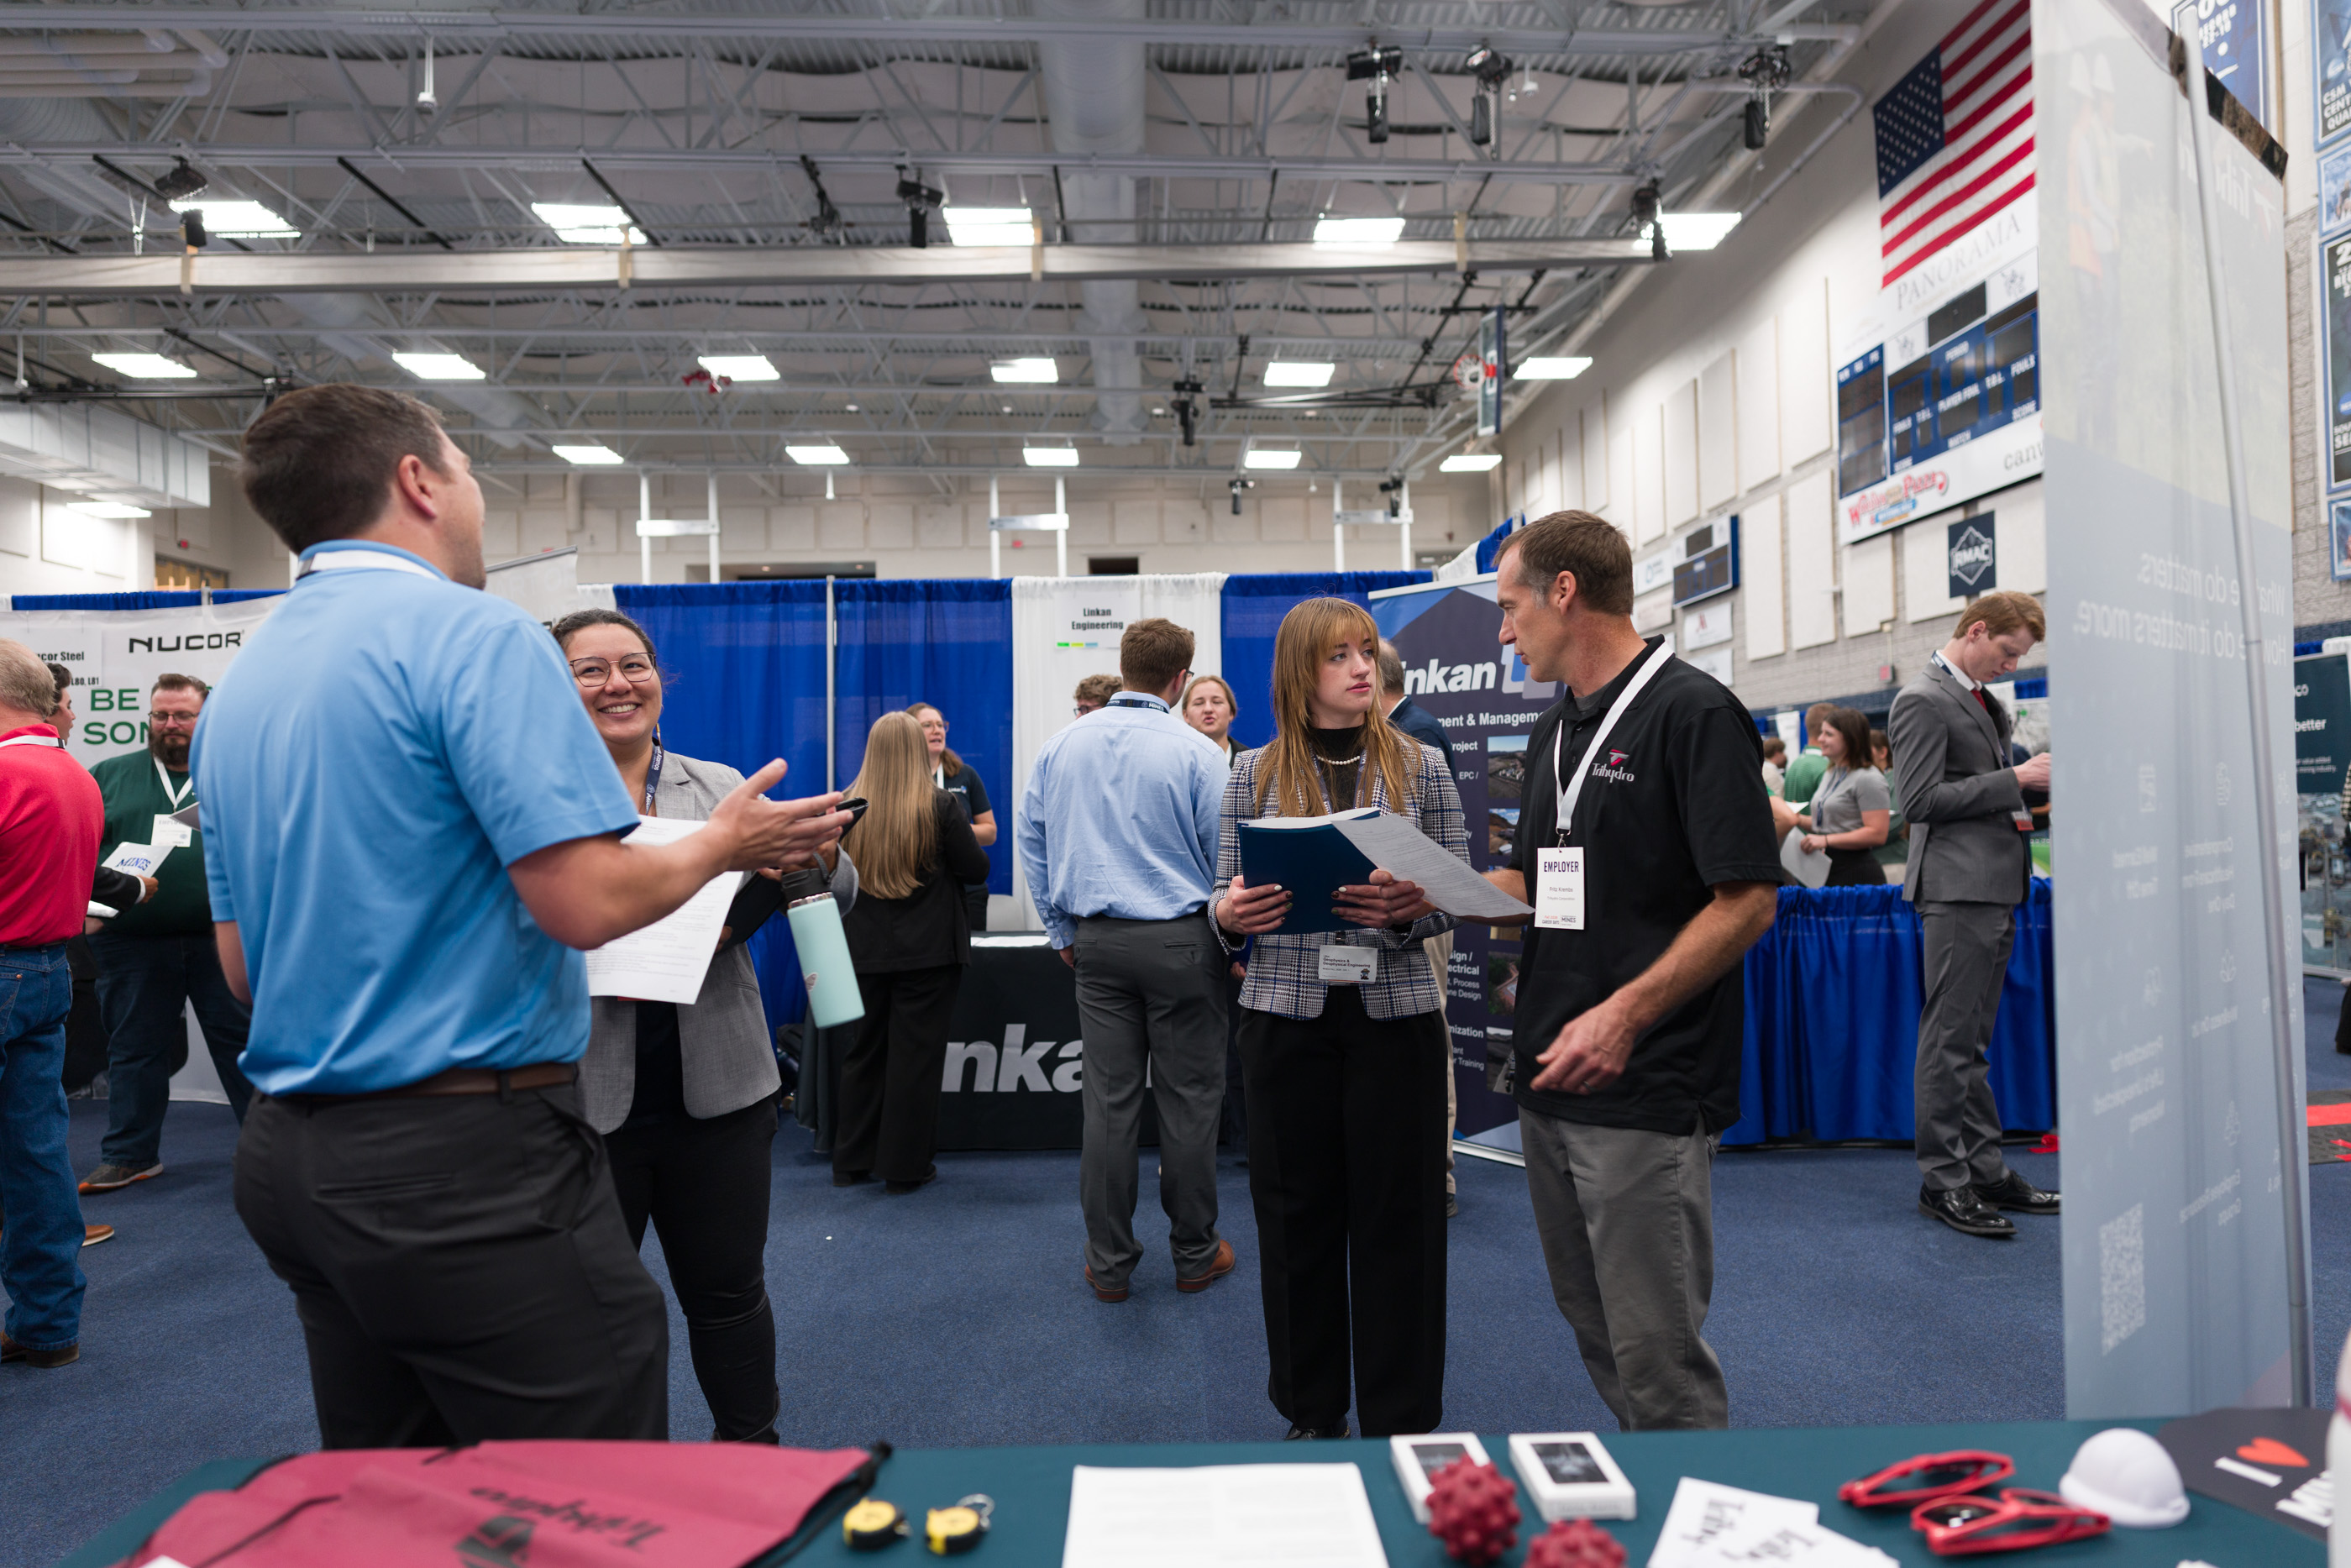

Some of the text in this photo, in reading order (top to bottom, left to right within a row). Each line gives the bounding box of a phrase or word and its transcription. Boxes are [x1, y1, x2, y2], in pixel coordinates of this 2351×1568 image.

[2324, 97, 2351, 119] CENT
[2327, 108, 2351, 131] QUA
[1897, 212, 2022, 311] PANORAMA
[2010, 354, 2036, 377] FOULS
[1954, 546, 1989, 567] RMAC
[1083, 607, 1111, 616] Linkan
[1072, 621, 1124, 631] Engineering
[129, 632, 241, 653] NUCOR
[60, 651, 85, 661] Steel
[1403, 658, 1497, 695] nkan
[2295, 684, 2309, 697] co
[91, 689, 139, 711] BE
[1466, 713, 1476, 726] &
[1479, 711, 1544, 727] Managem
[1451, 741, 1478, 753] roject
[1459, 771, 1474, 780] EPC
[1592, 763, 1635, 784] Trihydro
[115, 857, 151, 871] MINES
[1544, 861, 1579, 872] EMPLOYER
[1449, 951, 1467, 963] sign
[1447, 964, 1480, 976] ectrical
[1453, 978, 1480, 989] Process
[1458, 989, 1482, 1001] Design
[1448, 1025, 1484, 1038] mization
[941, 1023, 1083, 1093] nka
[1458, 1057, 1485, 1071] Training
